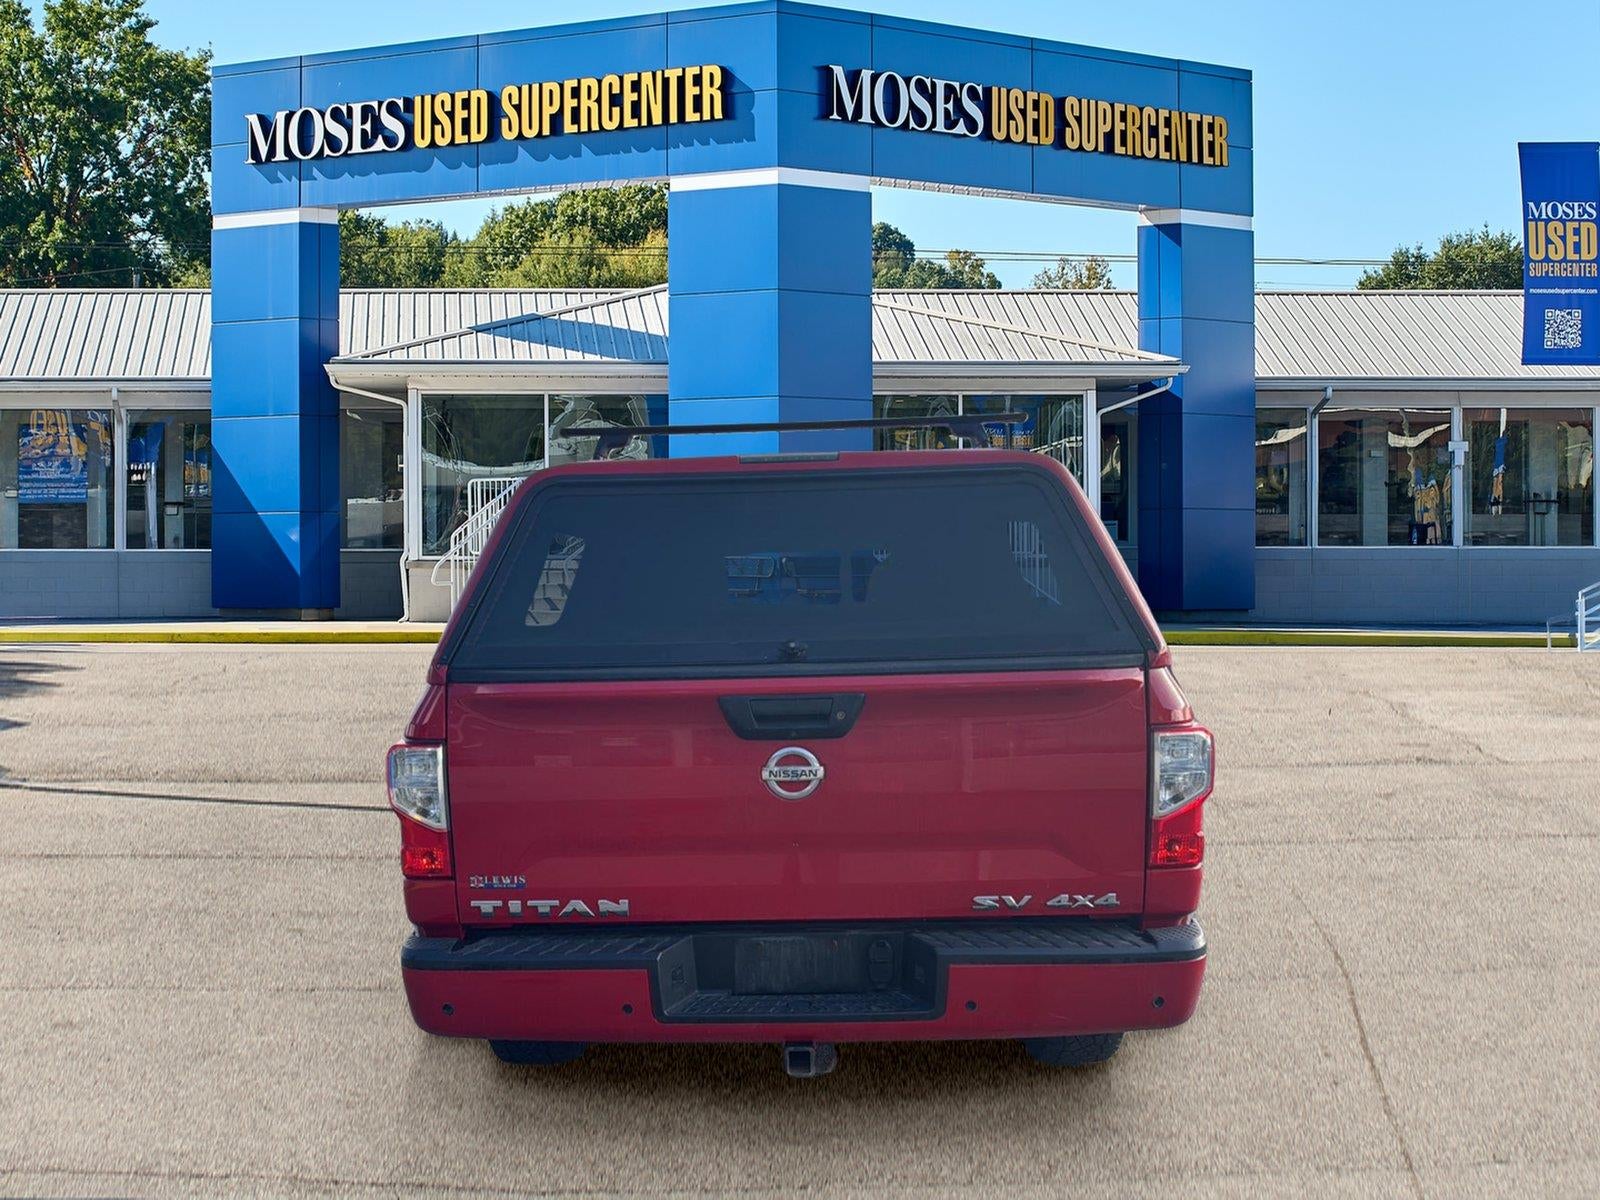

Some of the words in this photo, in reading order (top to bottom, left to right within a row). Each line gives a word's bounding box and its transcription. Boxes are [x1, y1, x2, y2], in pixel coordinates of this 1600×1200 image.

[244, 97, 406, 165] MOSES
[413, 88, 489, 149] USED
[501, 63, 724, 140] SUPERCENTER
[828, 64, 984, 138] MOSES
[990, 86, 1055, 146] USED
[1064, 95, 1229, 167] SUPERCENTER
[1527, 201, 1597, 220] MOSES
[1528, 221, 1598, 261] USED
[1529, 262, 1598, 277] SUPERCENTER
[768, 769, 818, 779] NISSAN
[484, 875, 526, 884] LEWIS
[470, 899, 630, 918] TITAN
[972, 895, 1033, 909] SV
